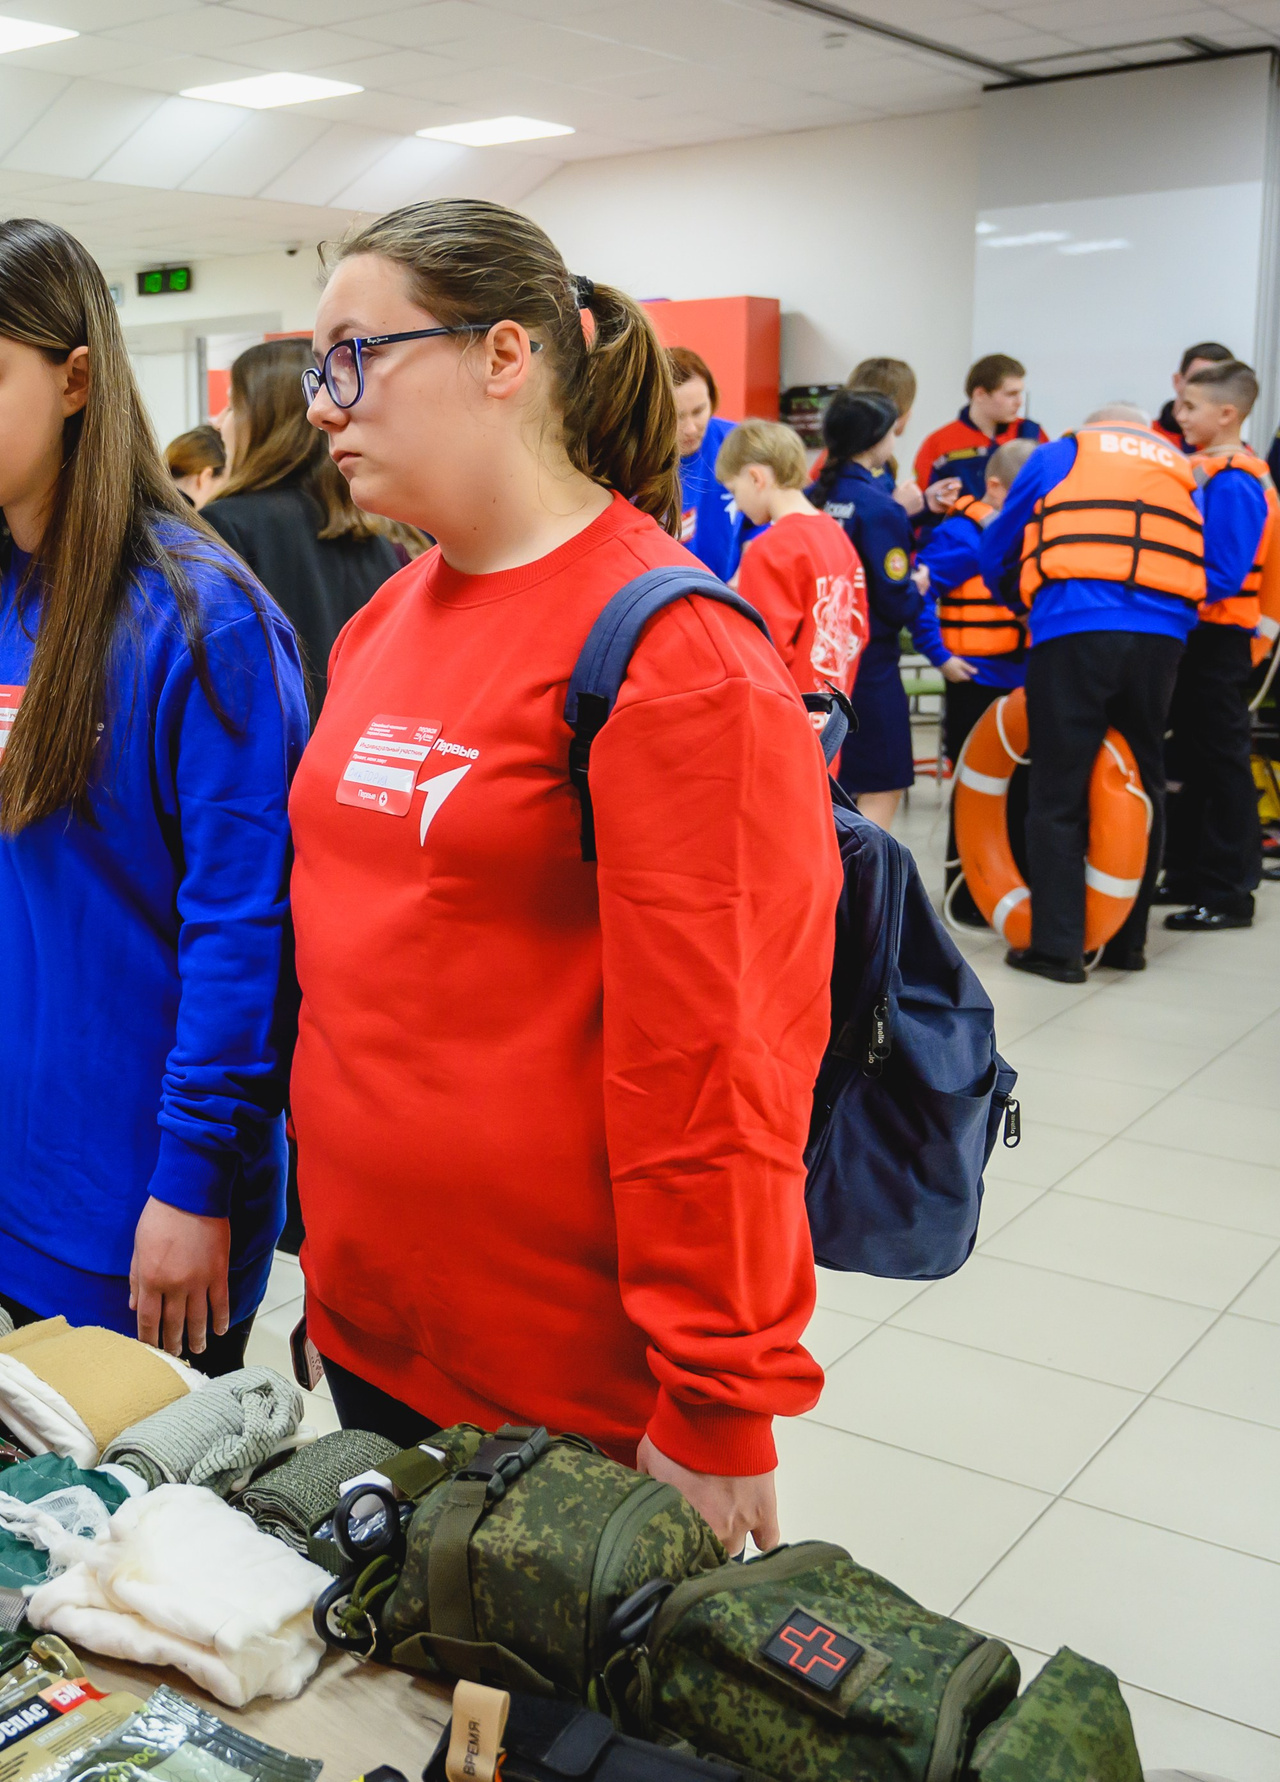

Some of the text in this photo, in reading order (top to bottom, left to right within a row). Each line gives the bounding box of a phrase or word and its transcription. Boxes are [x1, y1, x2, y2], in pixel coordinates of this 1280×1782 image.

[1100, 433, 1175, 468] ВСКС
[432, 738, 480, 760] Первые
[877, 1021, 885, 1044] anello
